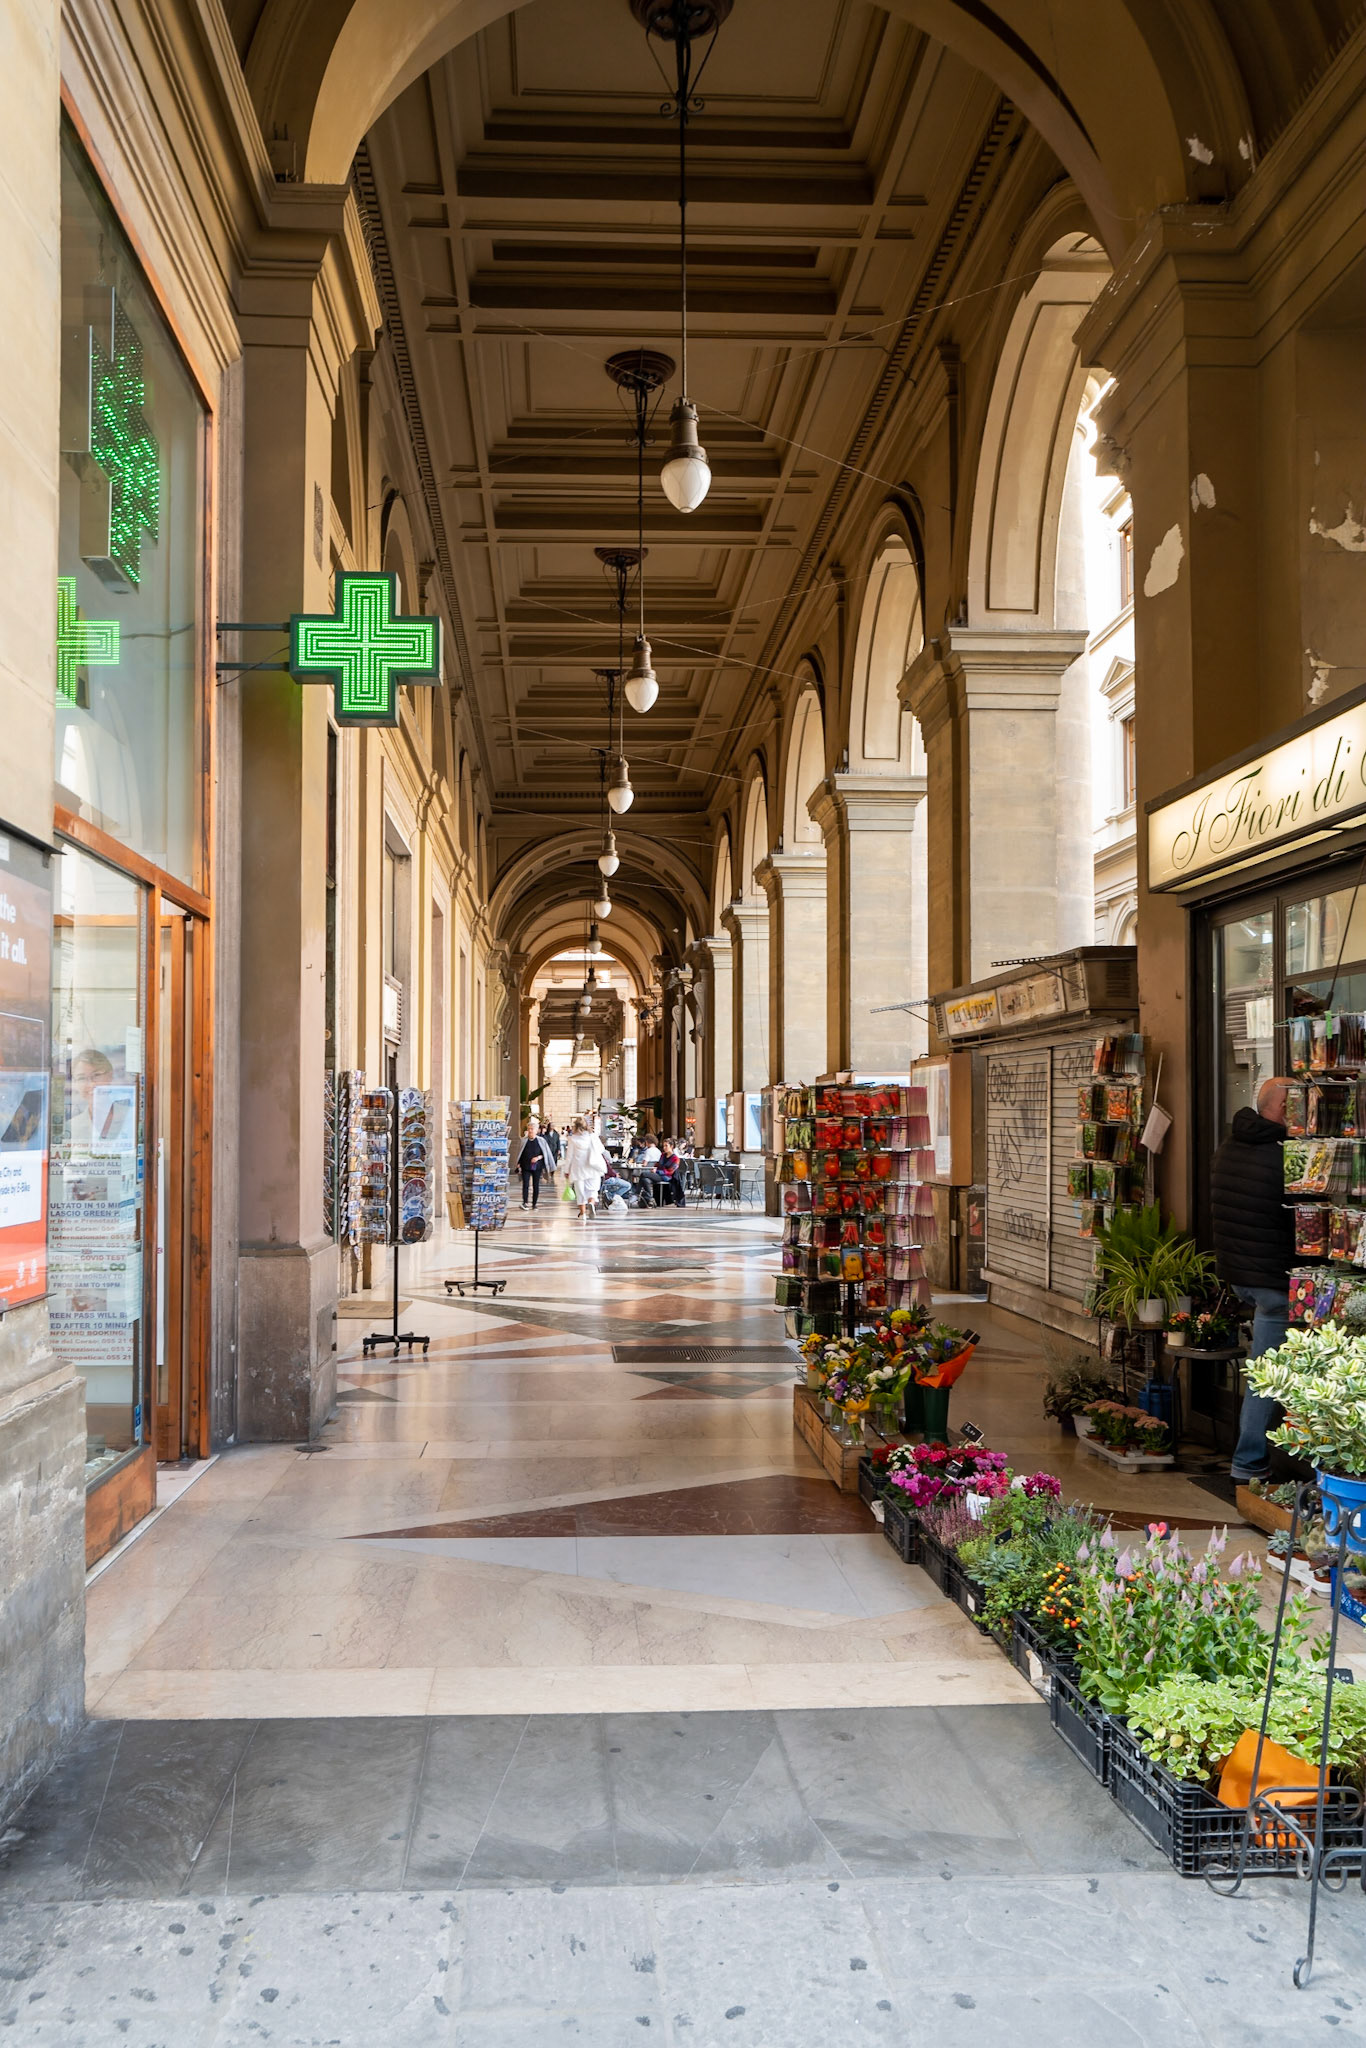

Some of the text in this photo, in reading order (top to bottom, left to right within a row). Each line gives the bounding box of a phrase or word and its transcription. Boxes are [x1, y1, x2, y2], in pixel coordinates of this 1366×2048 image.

[1172, 792, 1213, 870] I
[1208, 765, 1305, 854] Fiori
[1313, 736, 1350, 812] di
[475, 1122, 501, 1130] ITALIA
[475, 1195, 501, 1203] ITALIA
